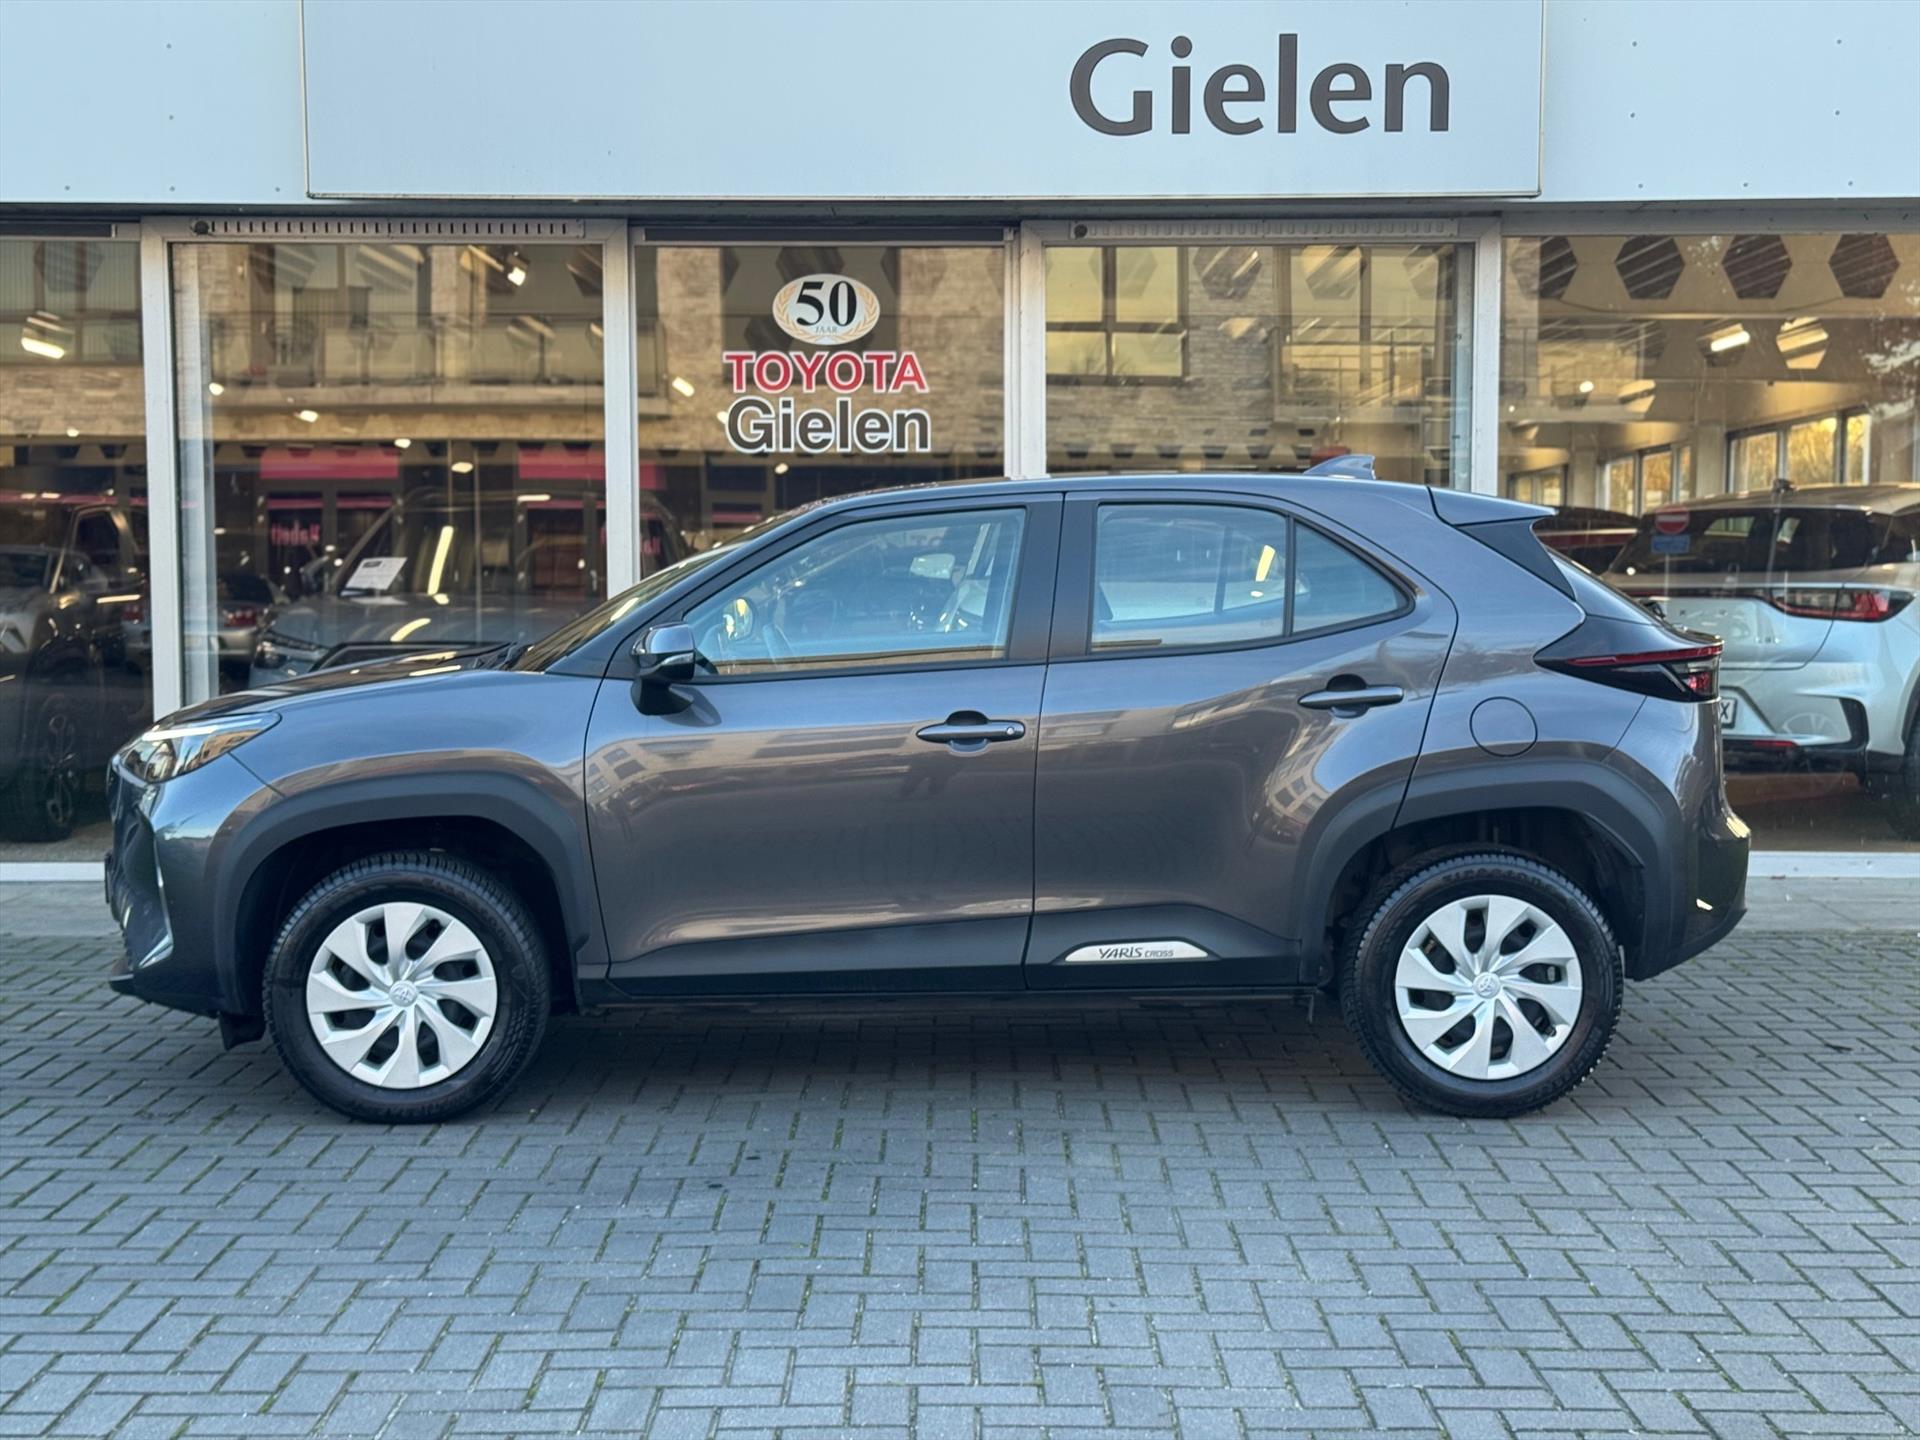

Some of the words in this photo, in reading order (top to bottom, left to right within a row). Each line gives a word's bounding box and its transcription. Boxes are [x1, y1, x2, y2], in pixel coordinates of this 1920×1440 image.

[1069, 33, 1450, 136] Gielen
[796, 280, 857, 327] 50
[724, 352, 928, 392] TOYOTA
[727, 397, 930, 452] Gielen
[1099, 946, 1143, 959] YARIS
[1144, 949, 1174, 958] CROSS
